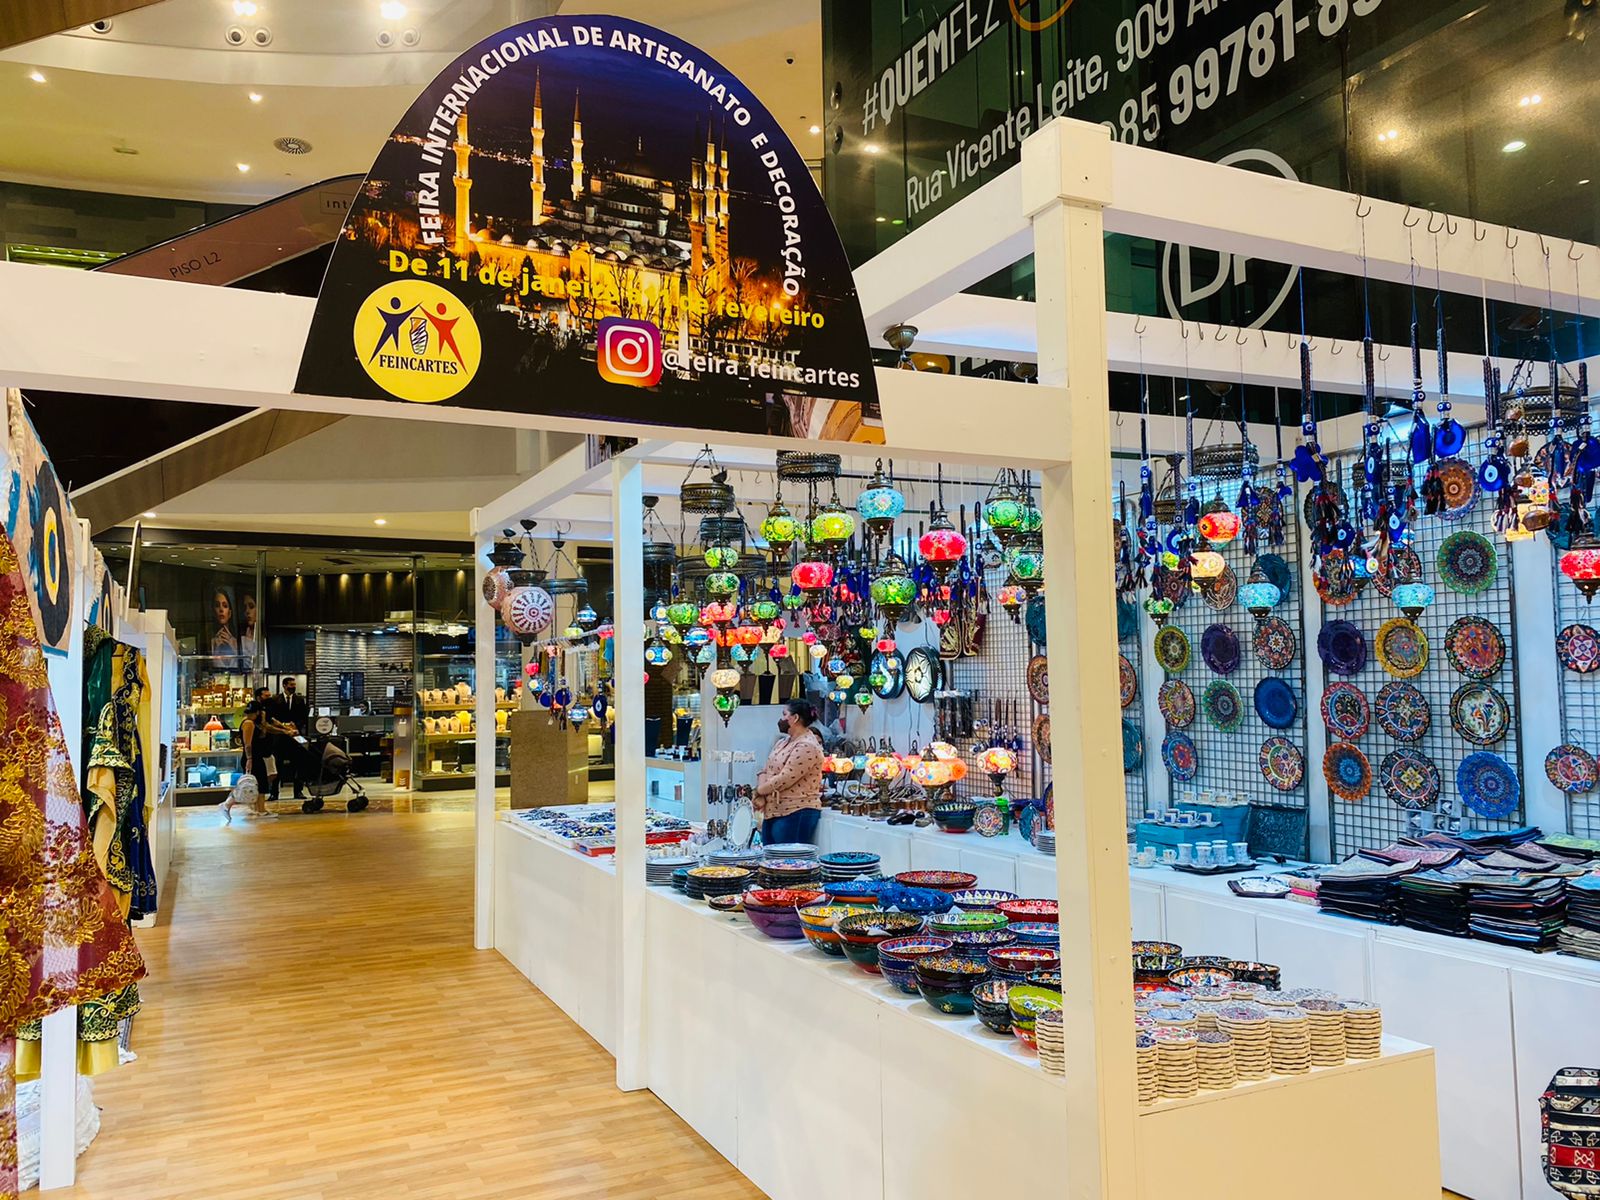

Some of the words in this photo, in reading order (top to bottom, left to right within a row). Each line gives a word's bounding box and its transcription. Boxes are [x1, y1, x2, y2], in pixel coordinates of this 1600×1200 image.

[572, 25, 604, 46] DE
[862, 0, 1000, 136] #QUEMFEZ
[1168, 0, 1385, 125] 99781-8
[421, 27, 569, 166] INTERNACIONAL
[609, 29, 752, 127] ARTESANATO
[906, 169, 942, 219] Rua
[946, 105, 1031, 189] Vicente
[1036, 54, 1109, 129] Leite,
[1115, 0, 1175, 73] 909
[751, 131, 769, 151] E
[326, 199, 352, 210] int
[418, 171, 445, 245] FEIRA
[760, 150, 806, 297] DECORAÇÃO
[169, 259, 201, 278] PISO
[203, 251, 222, 265] L2
[388, 249, 428, 276] De
[437, 256, 469, 282] 11
[478, 263, 514, 288] de
[519, 266, 621, 306] janeiro
[680, 283, 709, 315] de
[717, 293, 825, 329] fevereiro
[379, 354, 459, 375] FEINCARTES
[662, 347, 860, 388] @feira_feincartes
